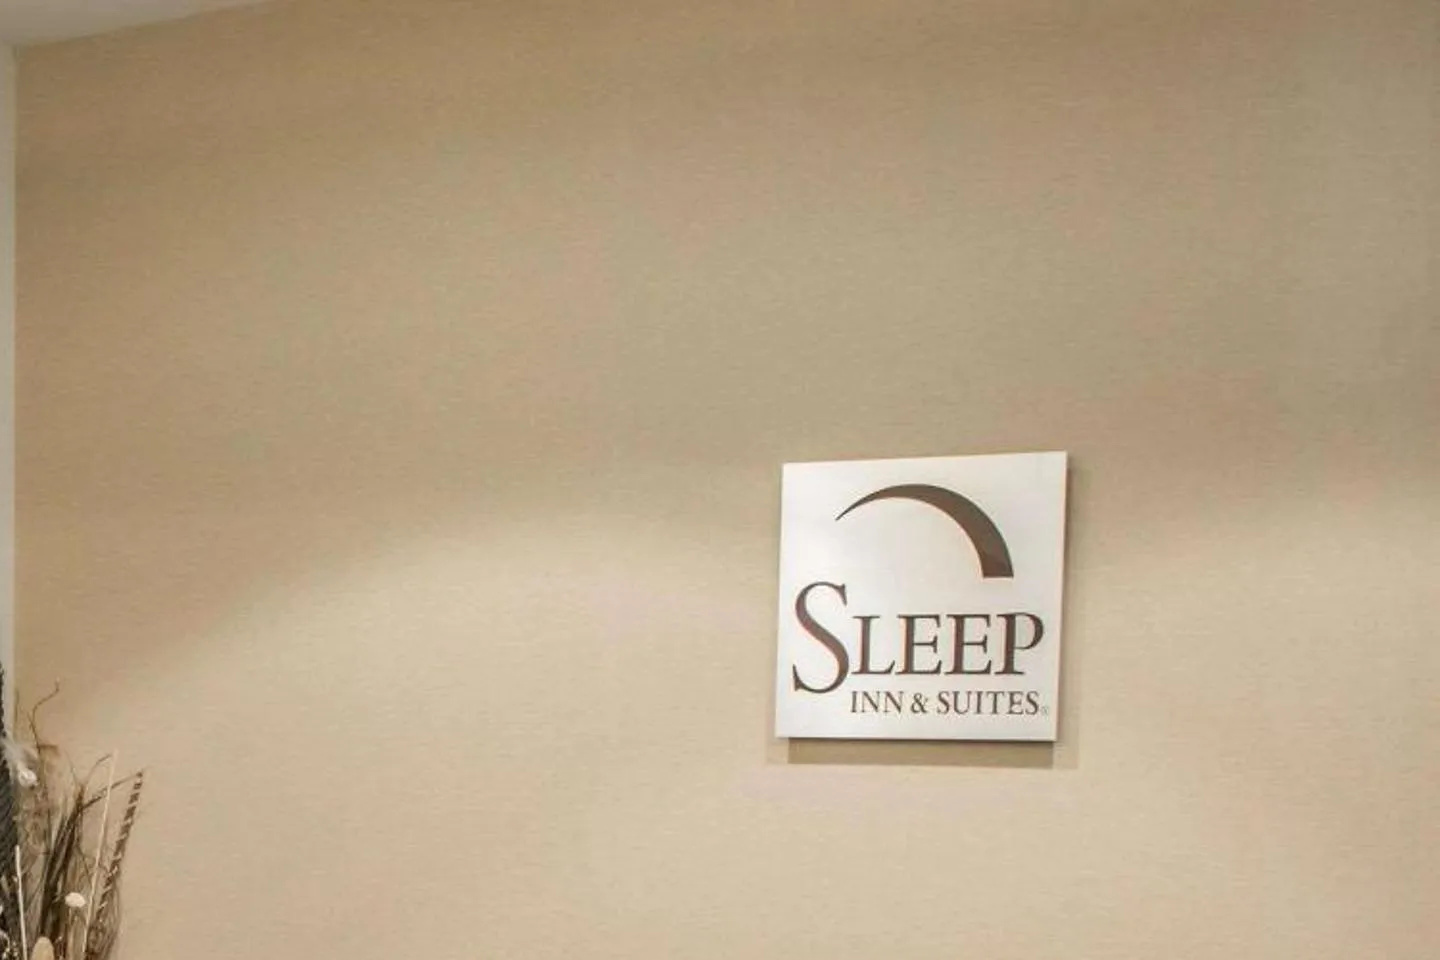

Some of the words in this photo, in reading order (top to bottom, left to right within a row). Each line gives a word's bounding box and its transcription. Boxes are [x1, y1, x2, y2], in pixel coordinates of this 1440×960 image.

[792, 580, 1045, 695] SLEEP
[850, 690, 904, 714] INN
[910, 692, 929, 714] &
[936, 690, 1040, 716] SUITES
